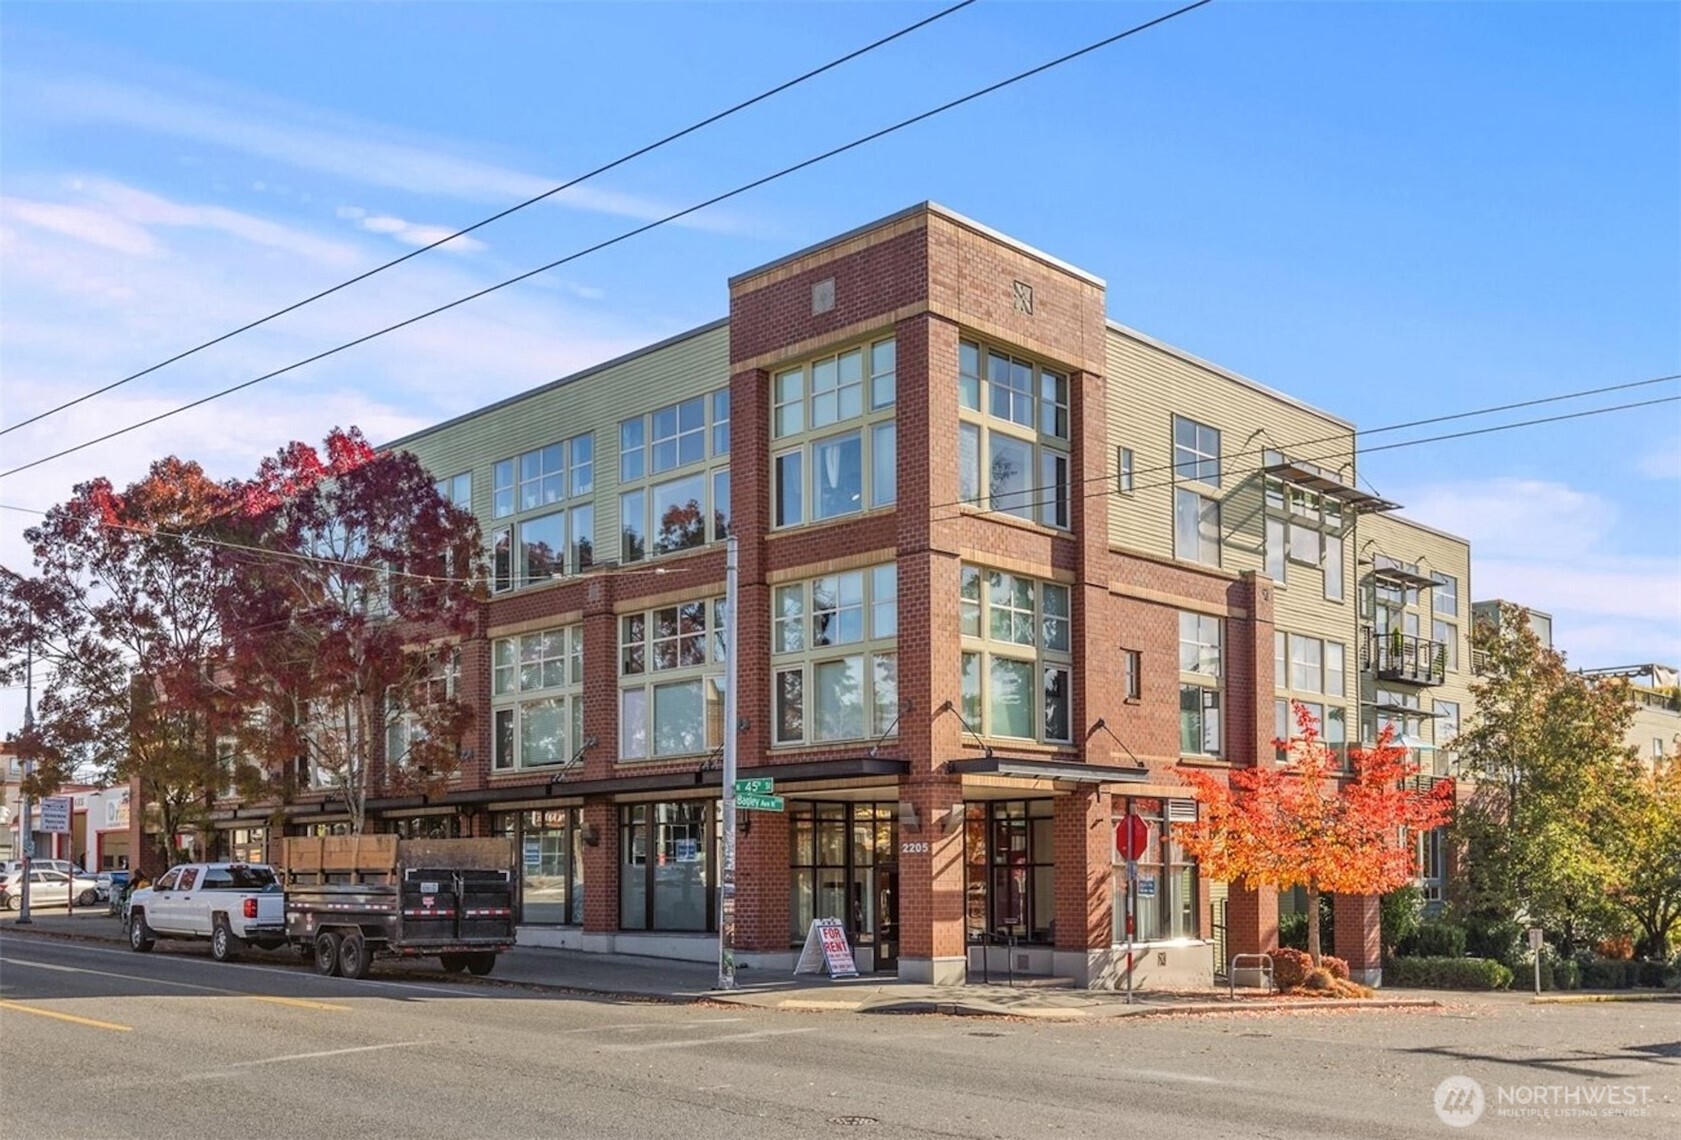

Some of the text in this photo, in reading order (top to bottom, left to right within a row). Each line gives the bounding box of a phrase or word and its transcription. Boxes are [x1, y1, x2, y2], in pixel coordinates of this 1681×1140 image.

[902, 843, 929, 853] 2205
[822, 927, 842, 939] FOR
[823, 940, 848, 953] RENT
